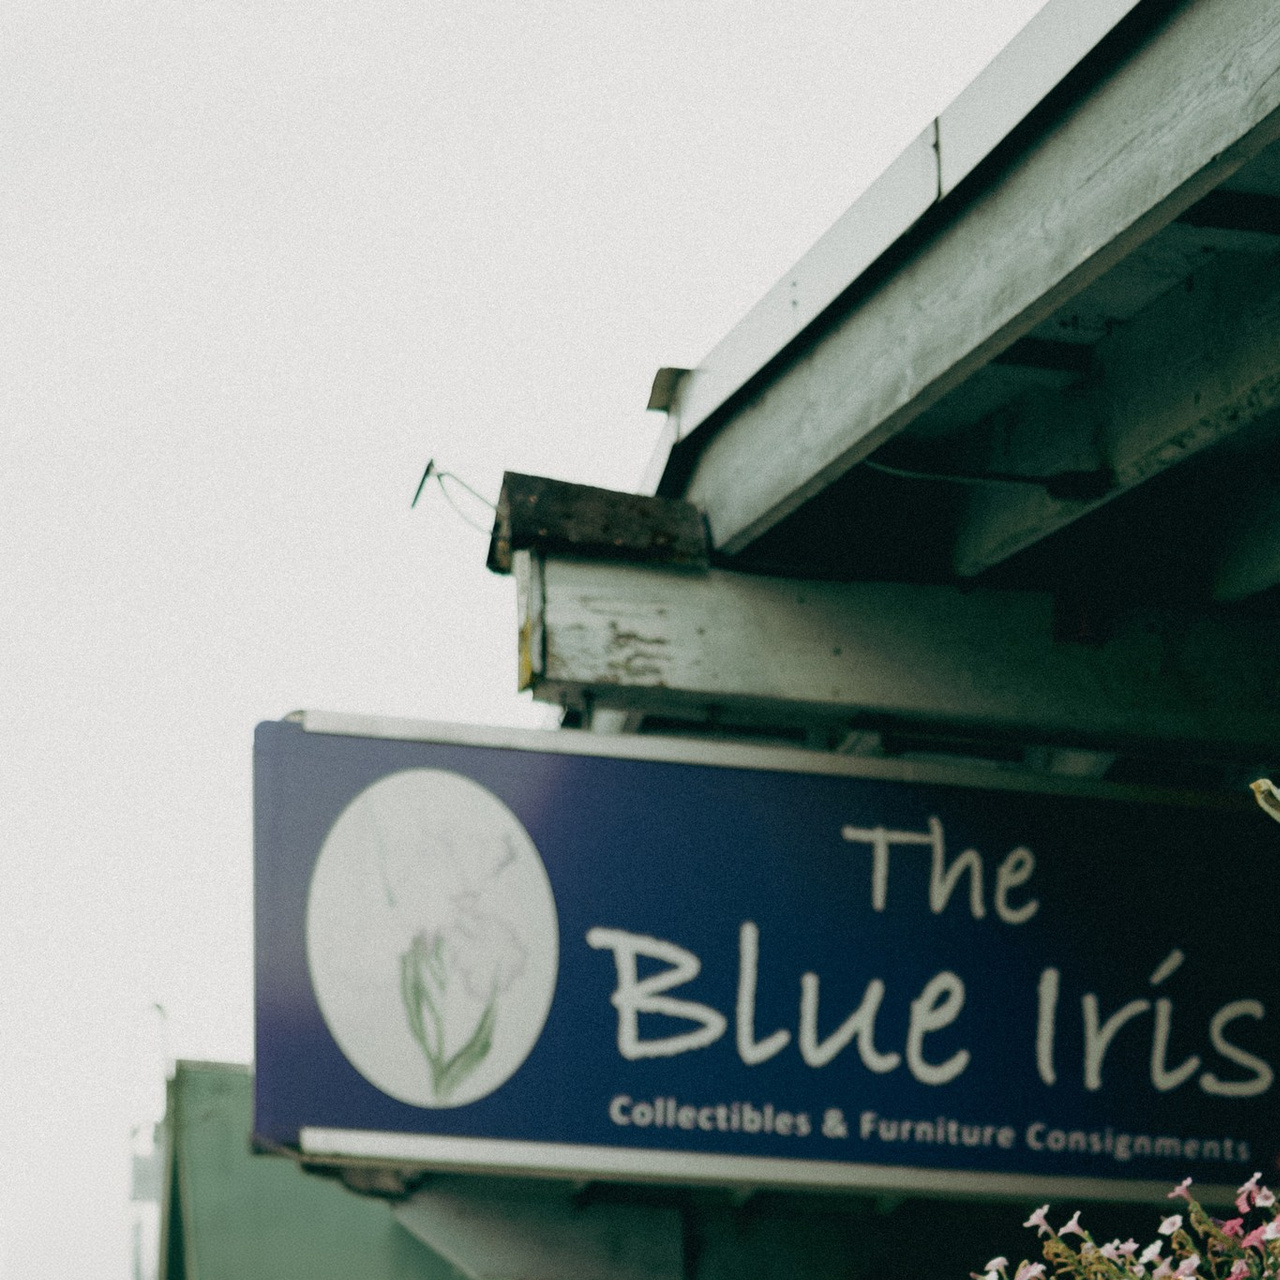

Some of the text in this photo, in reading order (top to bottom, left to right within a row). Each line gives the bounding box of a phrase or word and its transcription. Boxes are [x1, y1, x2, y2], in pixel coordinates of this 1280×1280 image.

[841, 815, 1040, 926] The
[584, 919, 972, 1088] Blue
[608, 1093, 1251, 1162] Collectibles & Furniture Consignments
